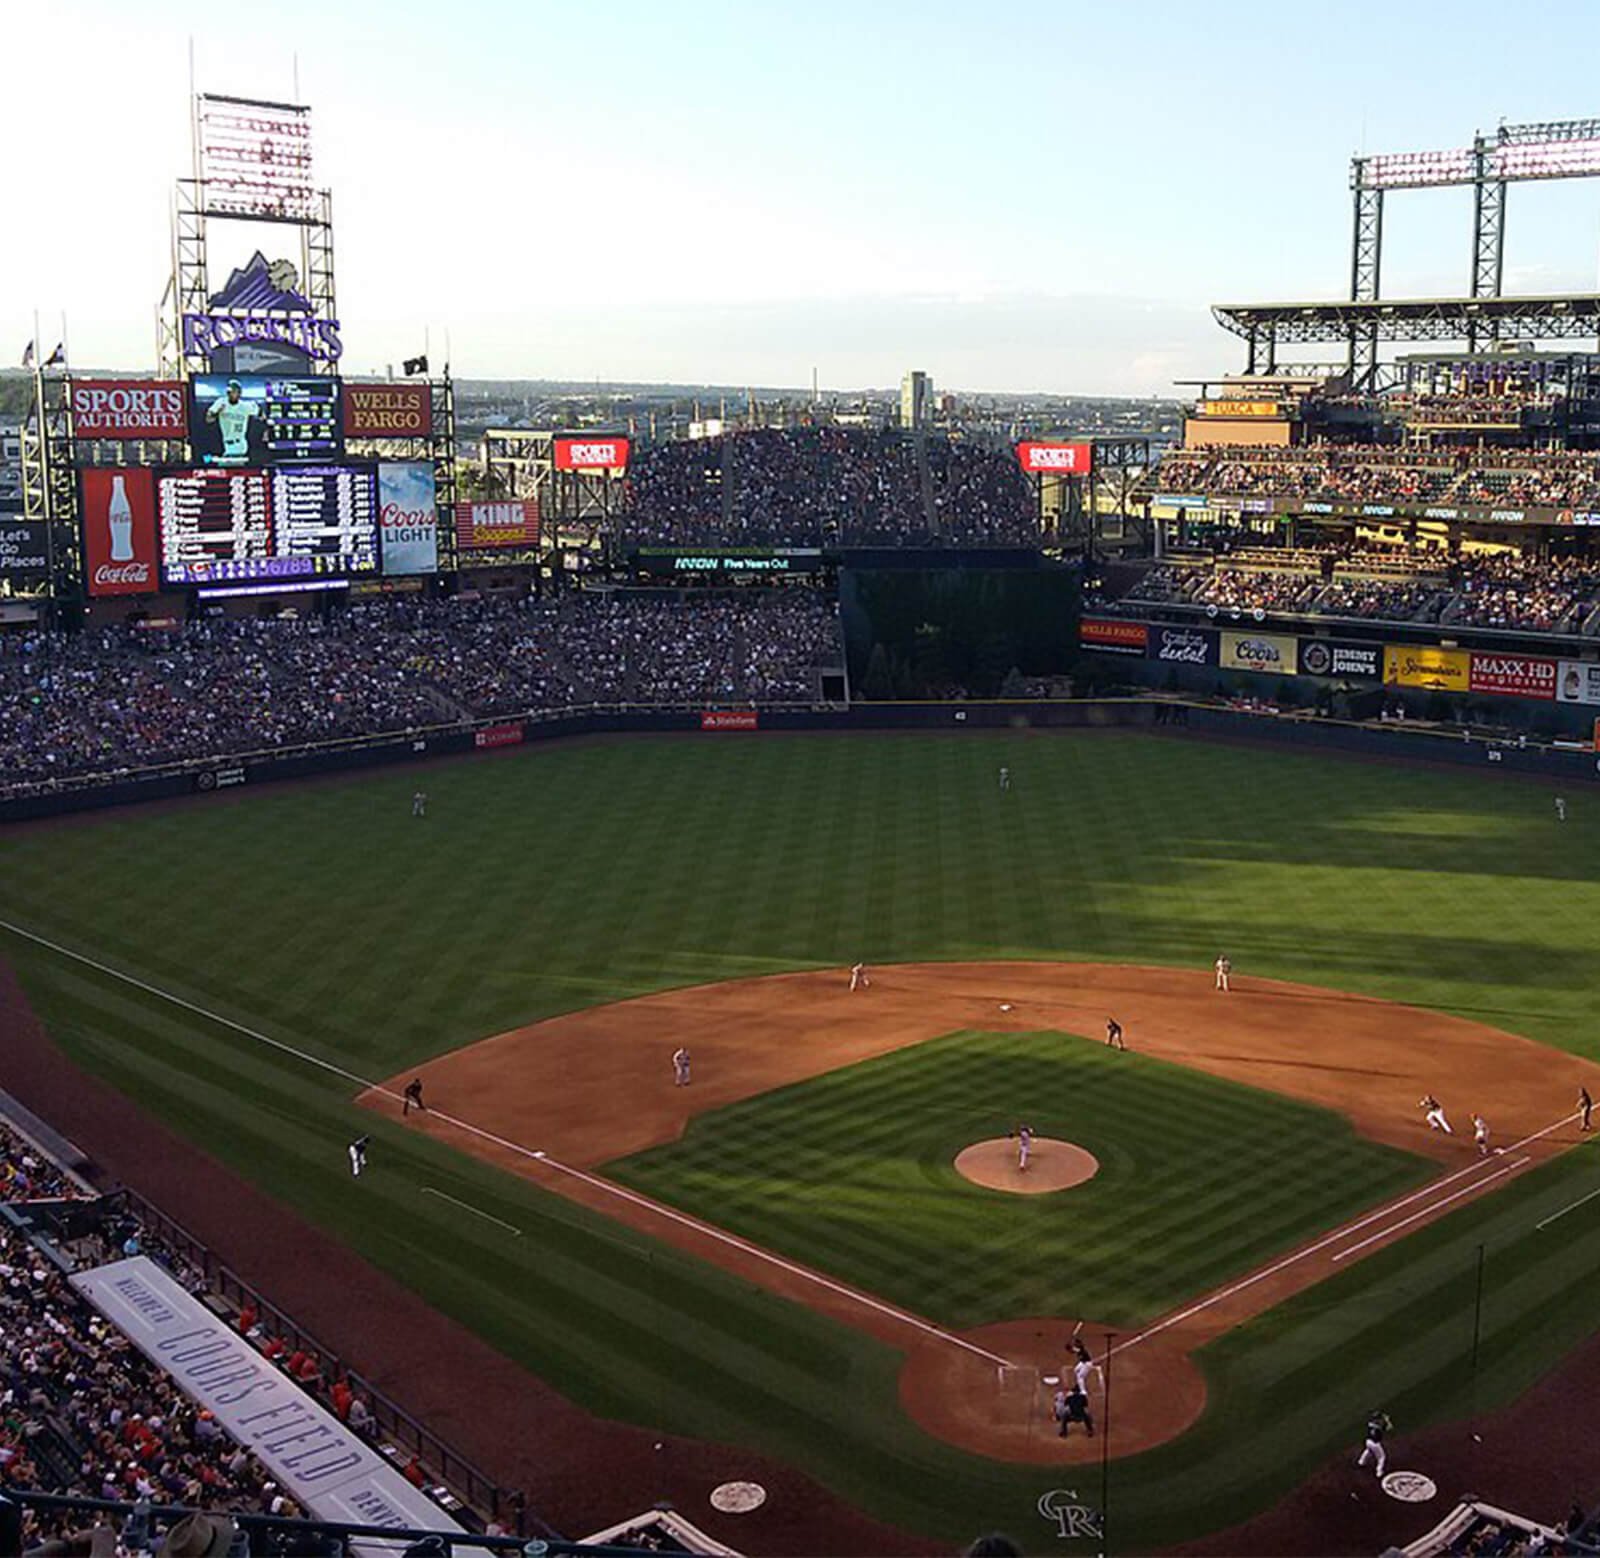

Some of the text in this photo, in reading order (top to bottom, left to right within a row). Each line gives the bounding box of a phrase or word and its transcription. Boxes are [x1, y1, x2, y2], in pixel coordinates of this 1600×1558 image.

[182, 314, 343, 361] ROCKIES
[75, 389, 182, 413] SPORTS
[351, 392, 420, 410] WELLS
[353, 411, 420, 428] FARGO
[381, 503, 436, 527] Coors
[472, 504, 525, 525] KING
[385, 528, 432, 543] LIGHT
[0, 543, 19, 555] Go
[1, 557, 45, 568] Places
[724, 558, 743, 569] Five
[770, 558, 789, 569] Out
[95, 563, 150, 584] Coca-Cola
[1113, 628, 1145, 639] FARGO
[1235, 641, 1280, 662] Coors
[1333, 648, 1376, 661] JIMMY
[1332, 660, 1376, 674] JOHN'S
[1472, 658, 1554, 679] MAXX HD
[157, 1328, 278, 1404] COORS
[238, 1401, 362, 1482] FIELD
